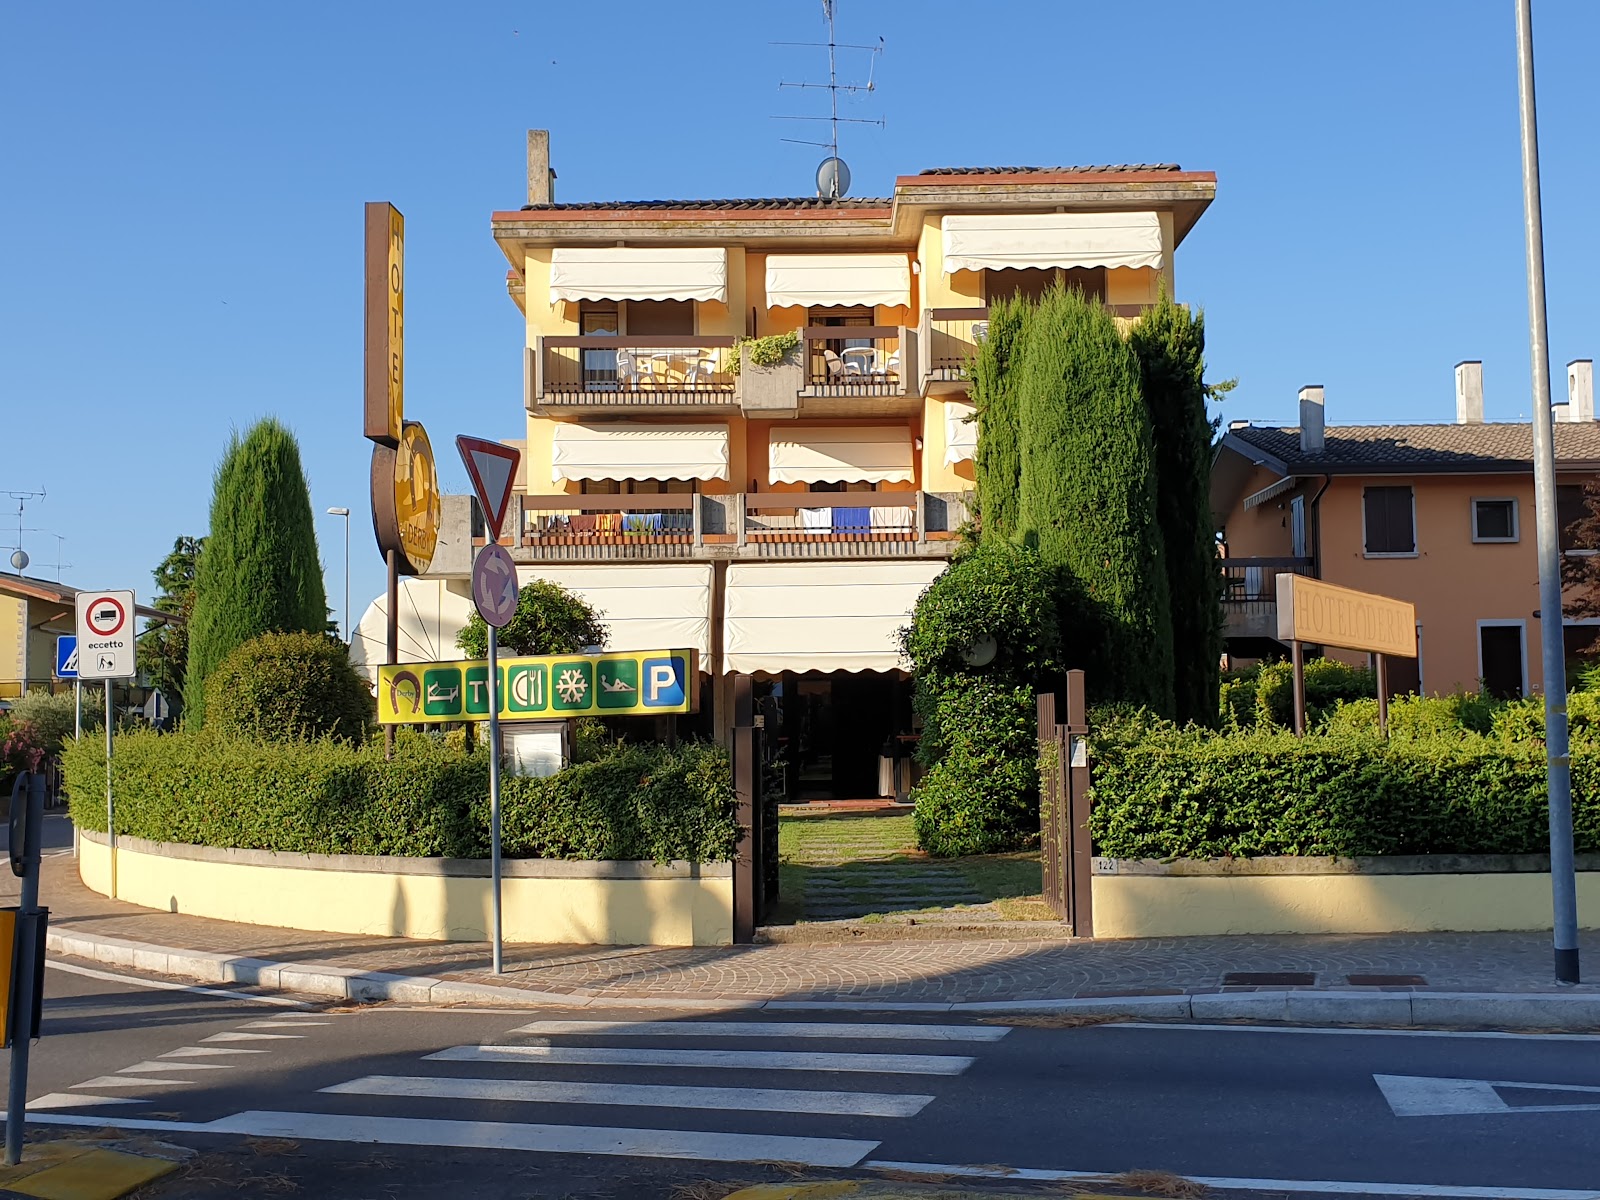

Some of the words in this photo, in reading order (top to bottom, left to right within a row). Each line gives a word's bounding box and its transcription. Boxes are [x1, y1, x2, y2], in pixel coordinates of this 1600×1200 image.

[391, 216, 400, 430] HOTEL
[407, 523, 433, 551] DERBY
[1297, 589, 1357, 637] HOTEL
[1366, 604, 1413, 646] DERBY
[88, 640, 124, 649] eccetto
[396, 689, 415, 699] Derby
[650, 665, 676, 700] P
[1098, 861, 1114, 870] 122
